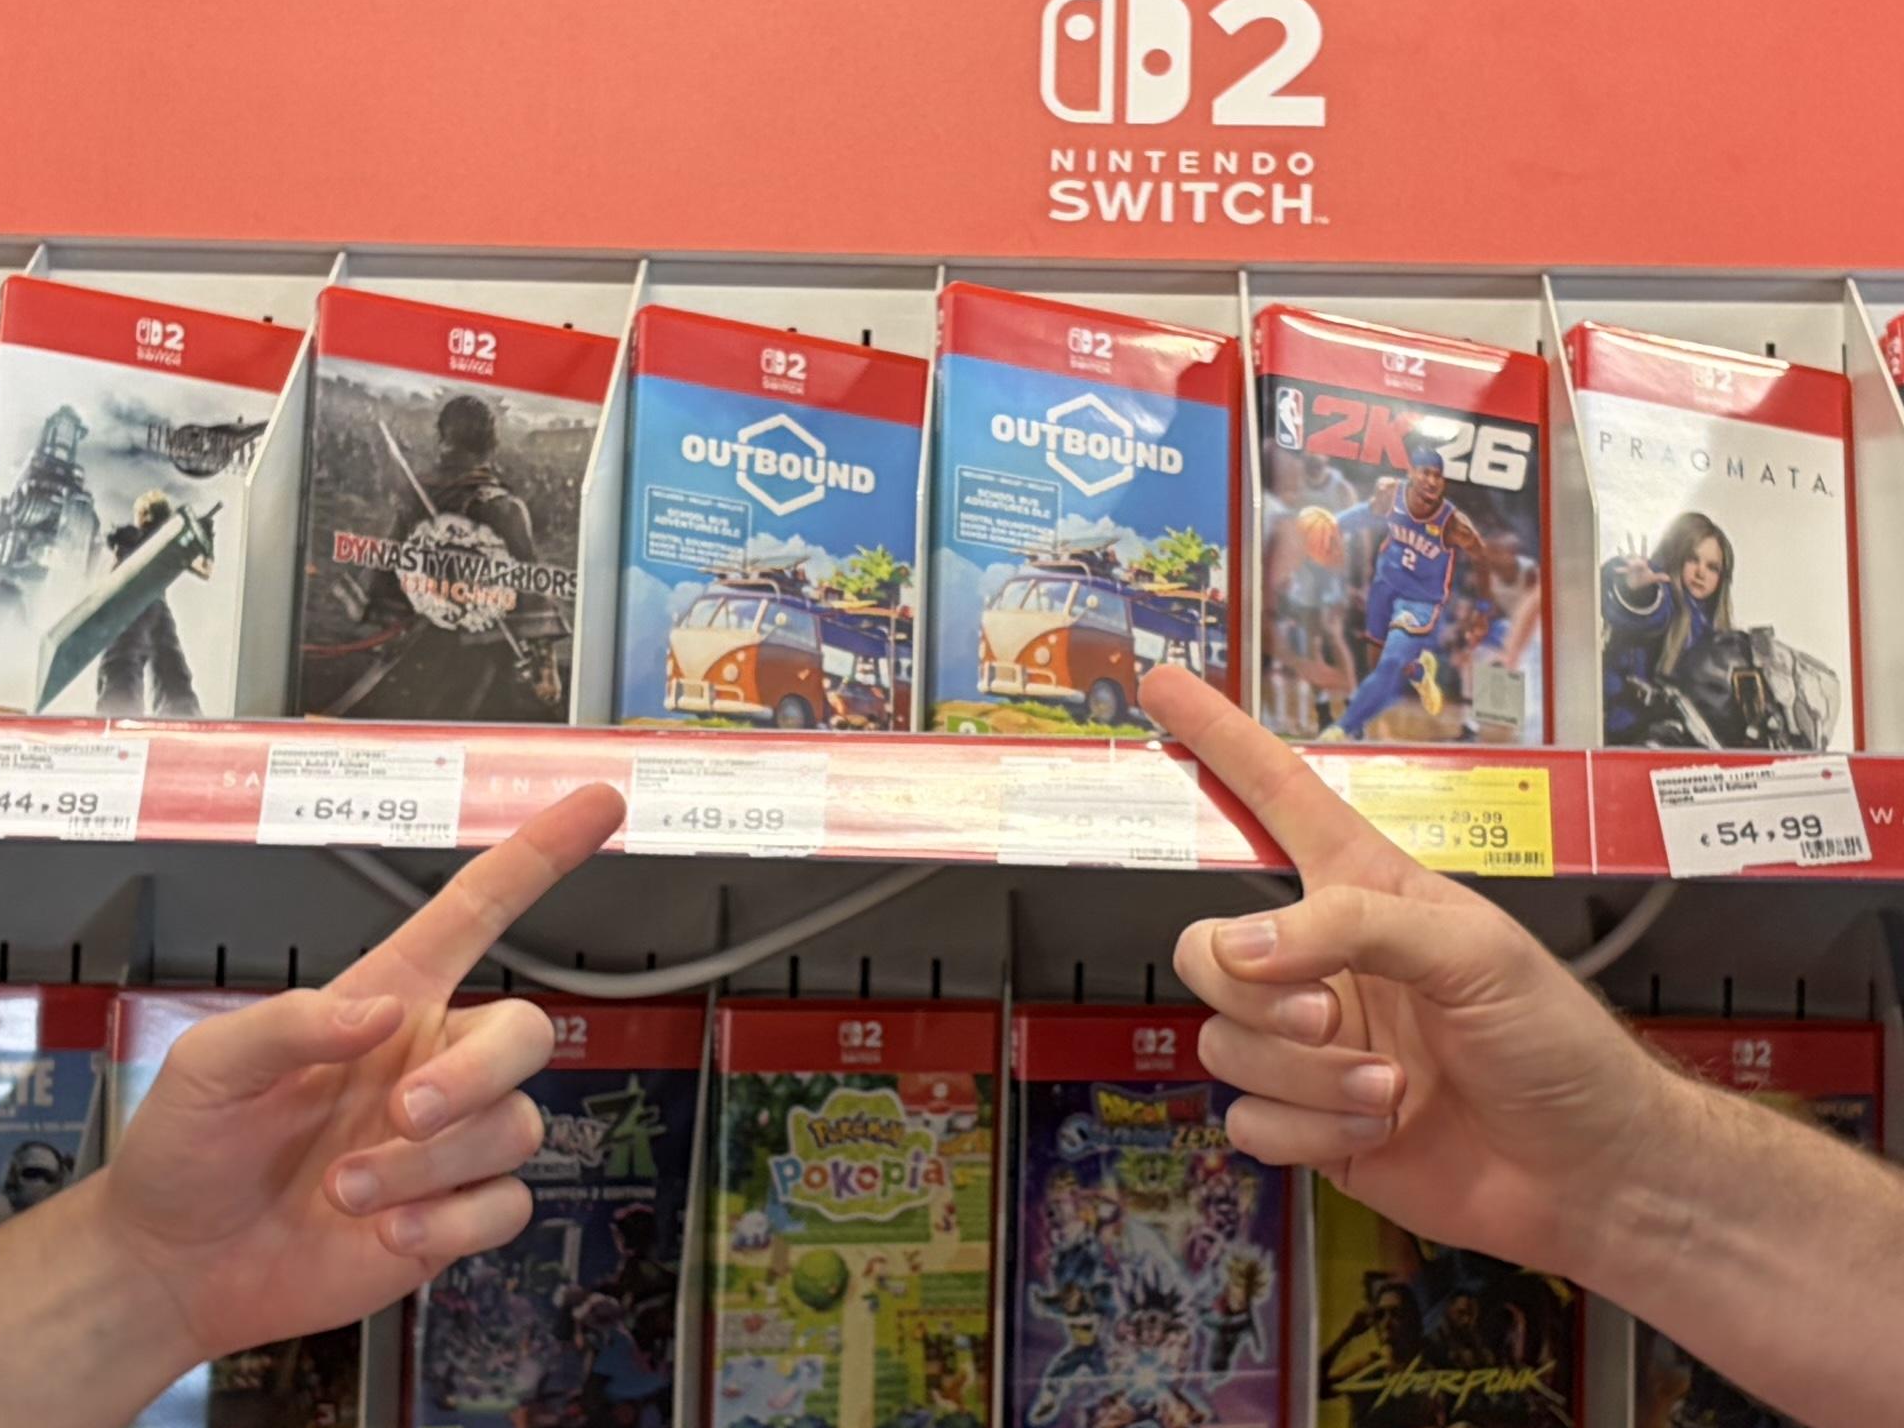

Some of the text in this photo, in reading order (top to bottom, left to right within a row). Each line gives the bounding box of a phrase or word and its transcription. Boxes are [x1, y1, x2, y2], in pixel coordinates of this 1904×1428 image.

[1050, 148, 1315, 177] NINTENDO
[1048, 179, 1313, 225] SWITCH
[681, 433, 876, 495] OUTBOUND
[991, 413, 1184, 476] OUTBOUND
[332, 529, 579, 598] DYNASTY WARRIORS
[313, 797, 419, 821] 64,99
[681, 806, 786, 831] 49,99
[1715, 813, 1824, 847] 54,99
